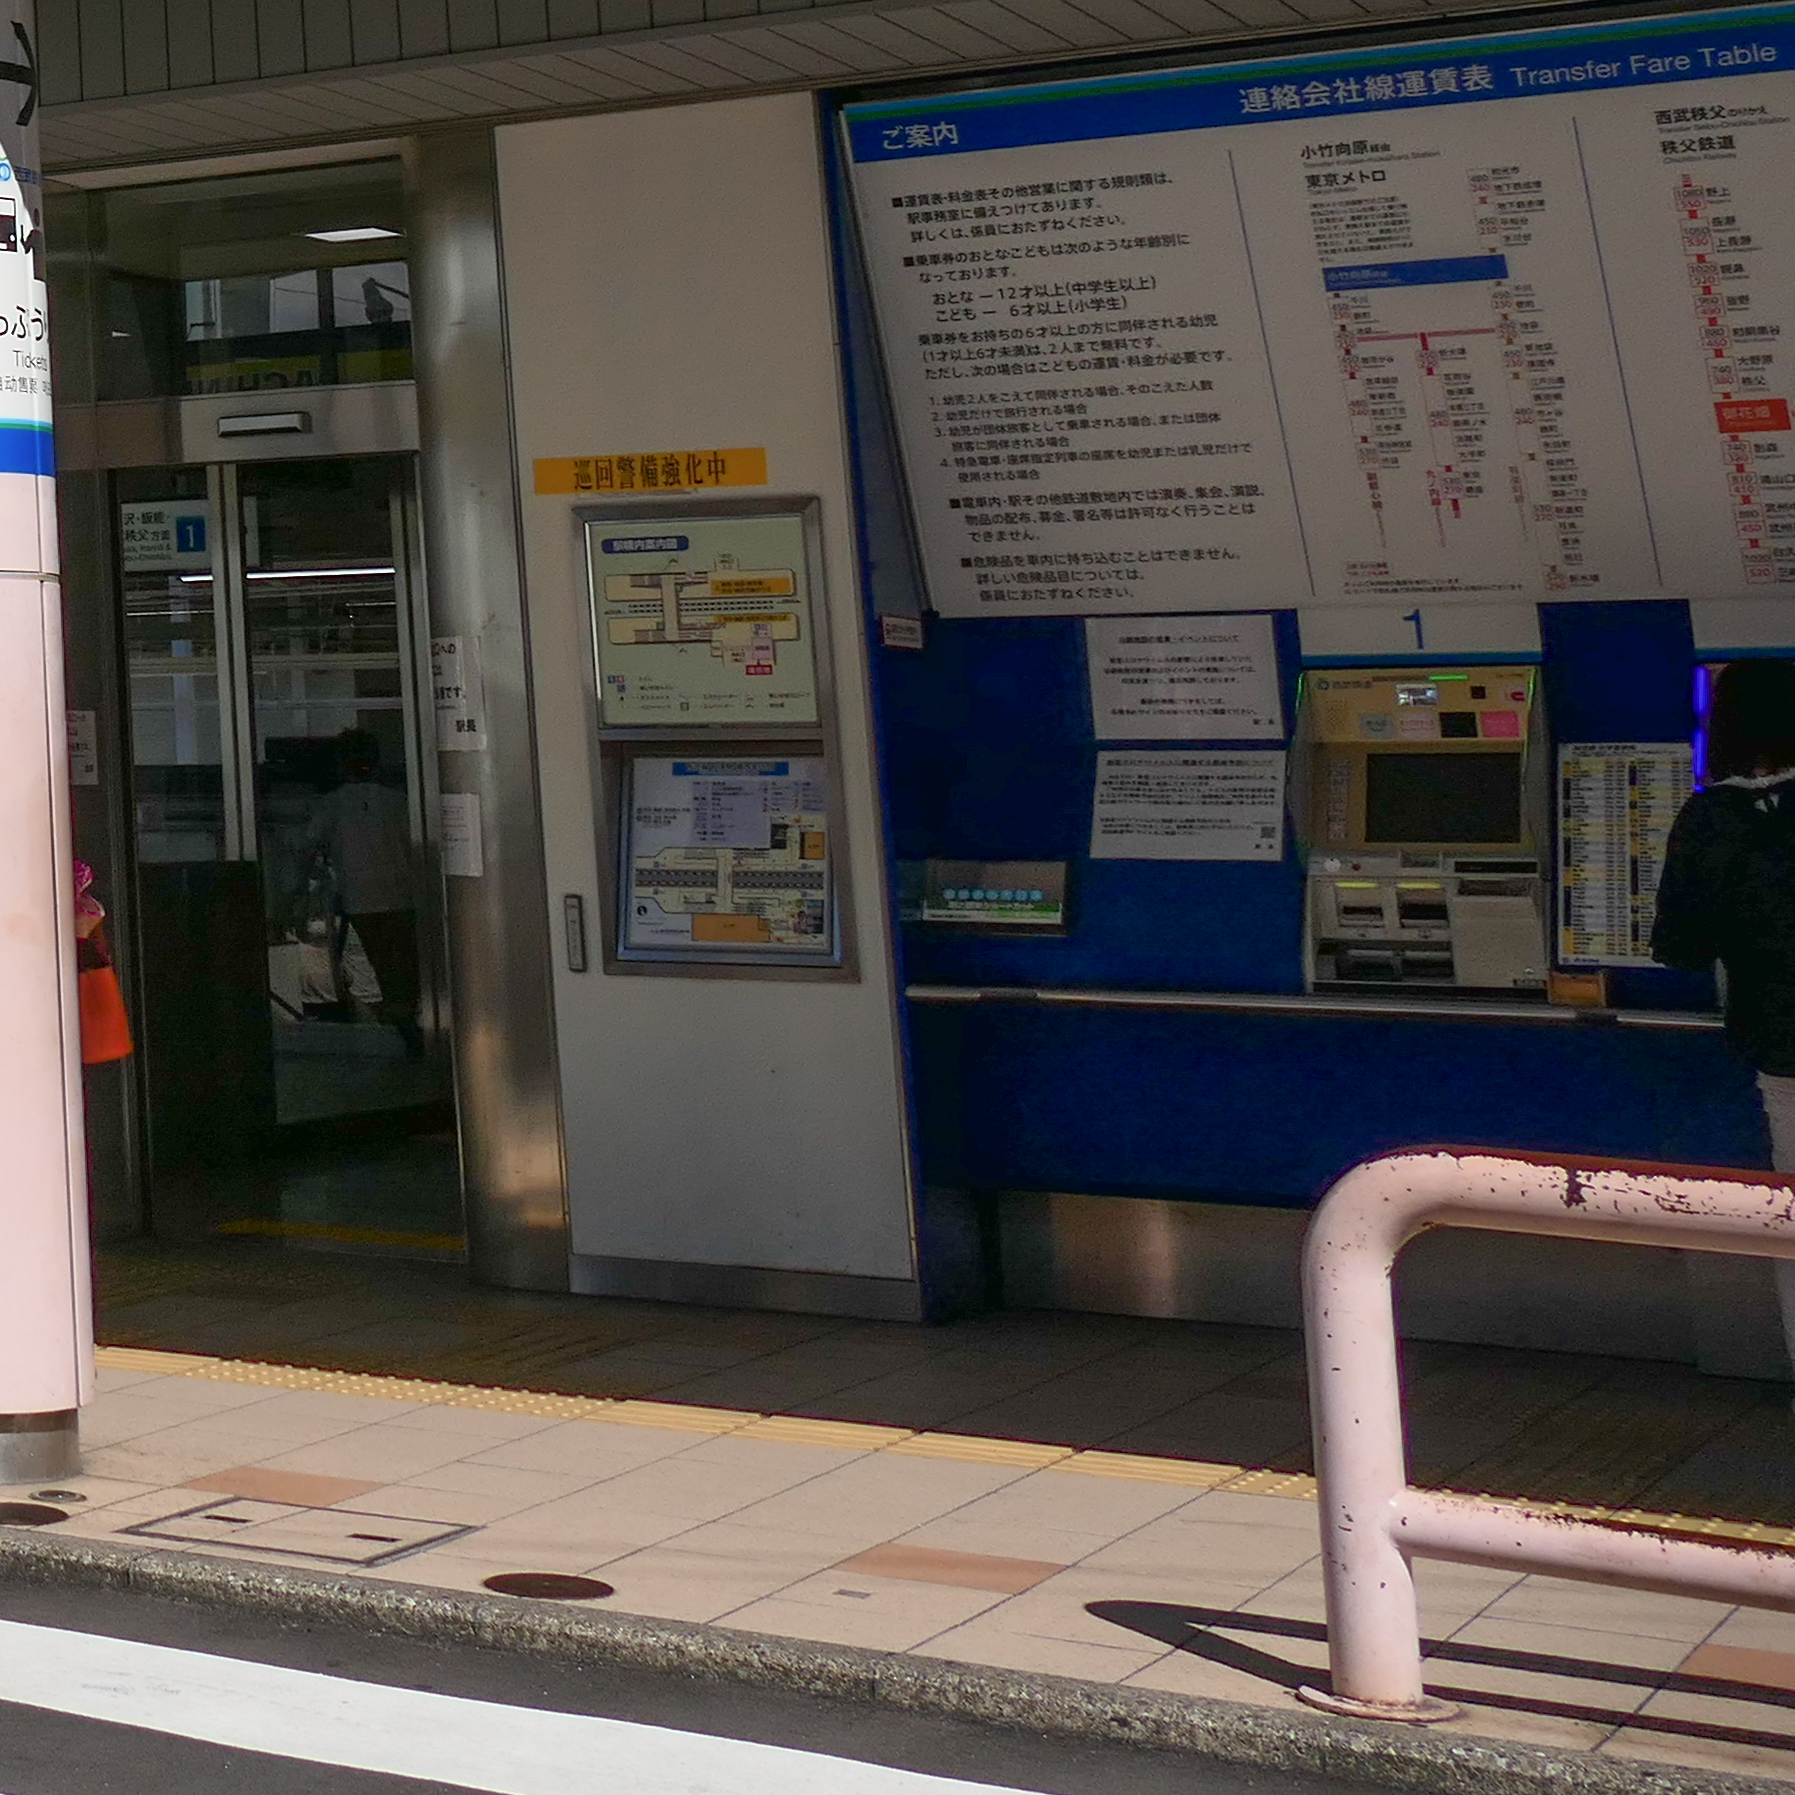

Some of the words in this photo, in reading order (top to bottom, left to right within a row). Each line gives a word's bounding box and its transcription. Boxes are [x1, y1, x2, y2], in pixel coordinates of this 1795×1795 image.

[1239, 63, 1496, 115] 連絡会社線運賃表
[1509, 59, 1619, 89] Transfer
[1628, 51, 1691, 76] Fare
[1698, 42, 1778, 68] Table
[880, 120, 960, 151] ご案内
[12, 349, 49, 370] Tickets
[573, 451, 726, 491] 巡回警備強化中
[185, 524, 195, 548] 1
[1403, 608, 1425, 650] 1
